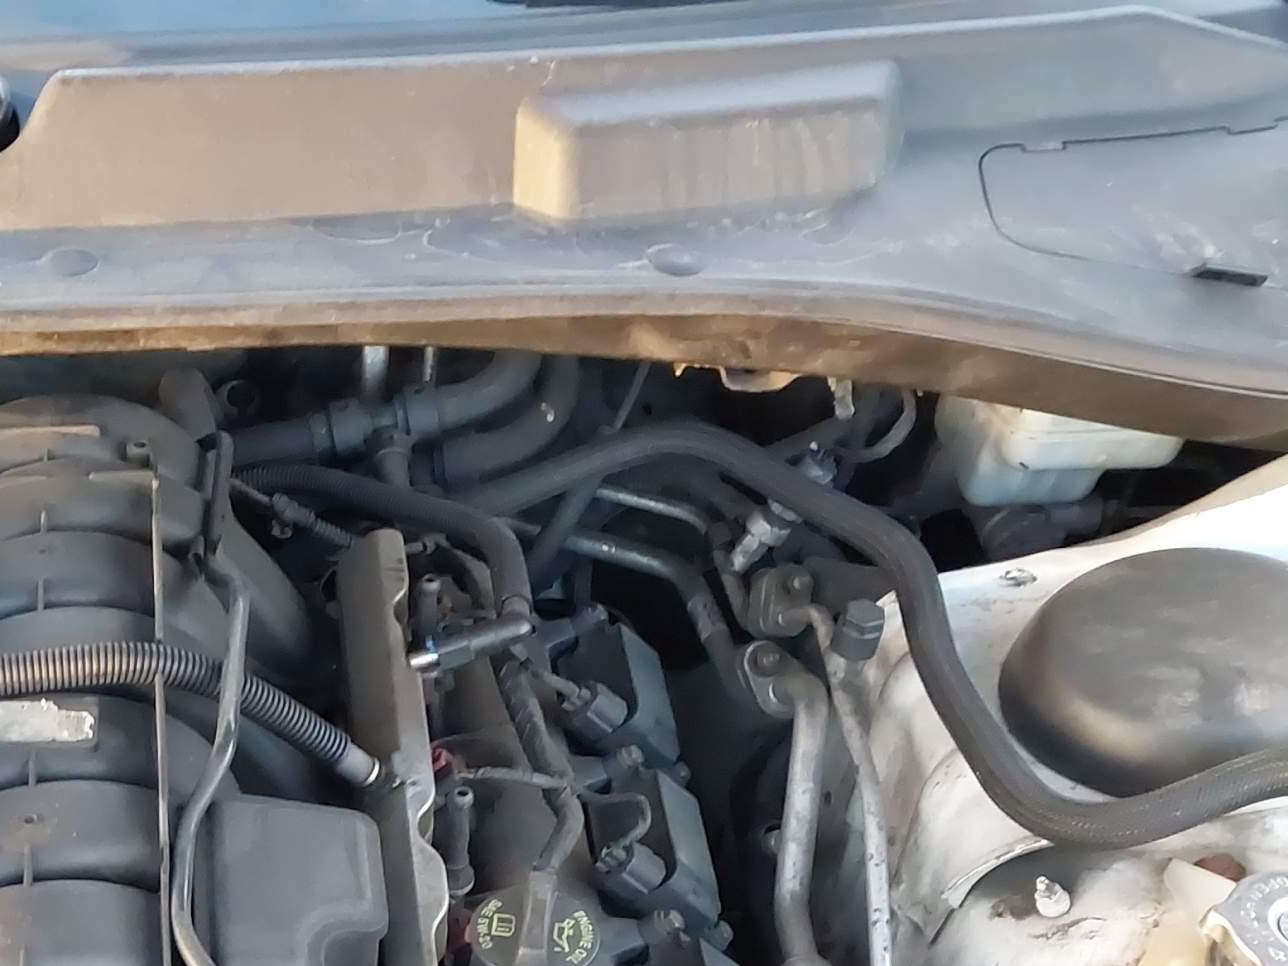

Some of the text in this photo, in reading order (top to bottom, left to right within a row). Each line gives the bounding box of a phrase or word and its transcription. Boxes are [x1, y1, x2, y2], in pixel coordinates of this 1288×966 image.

[481, 899, 503, 918] SAE
[566, 910, 593, 965] ENGINE OIL
